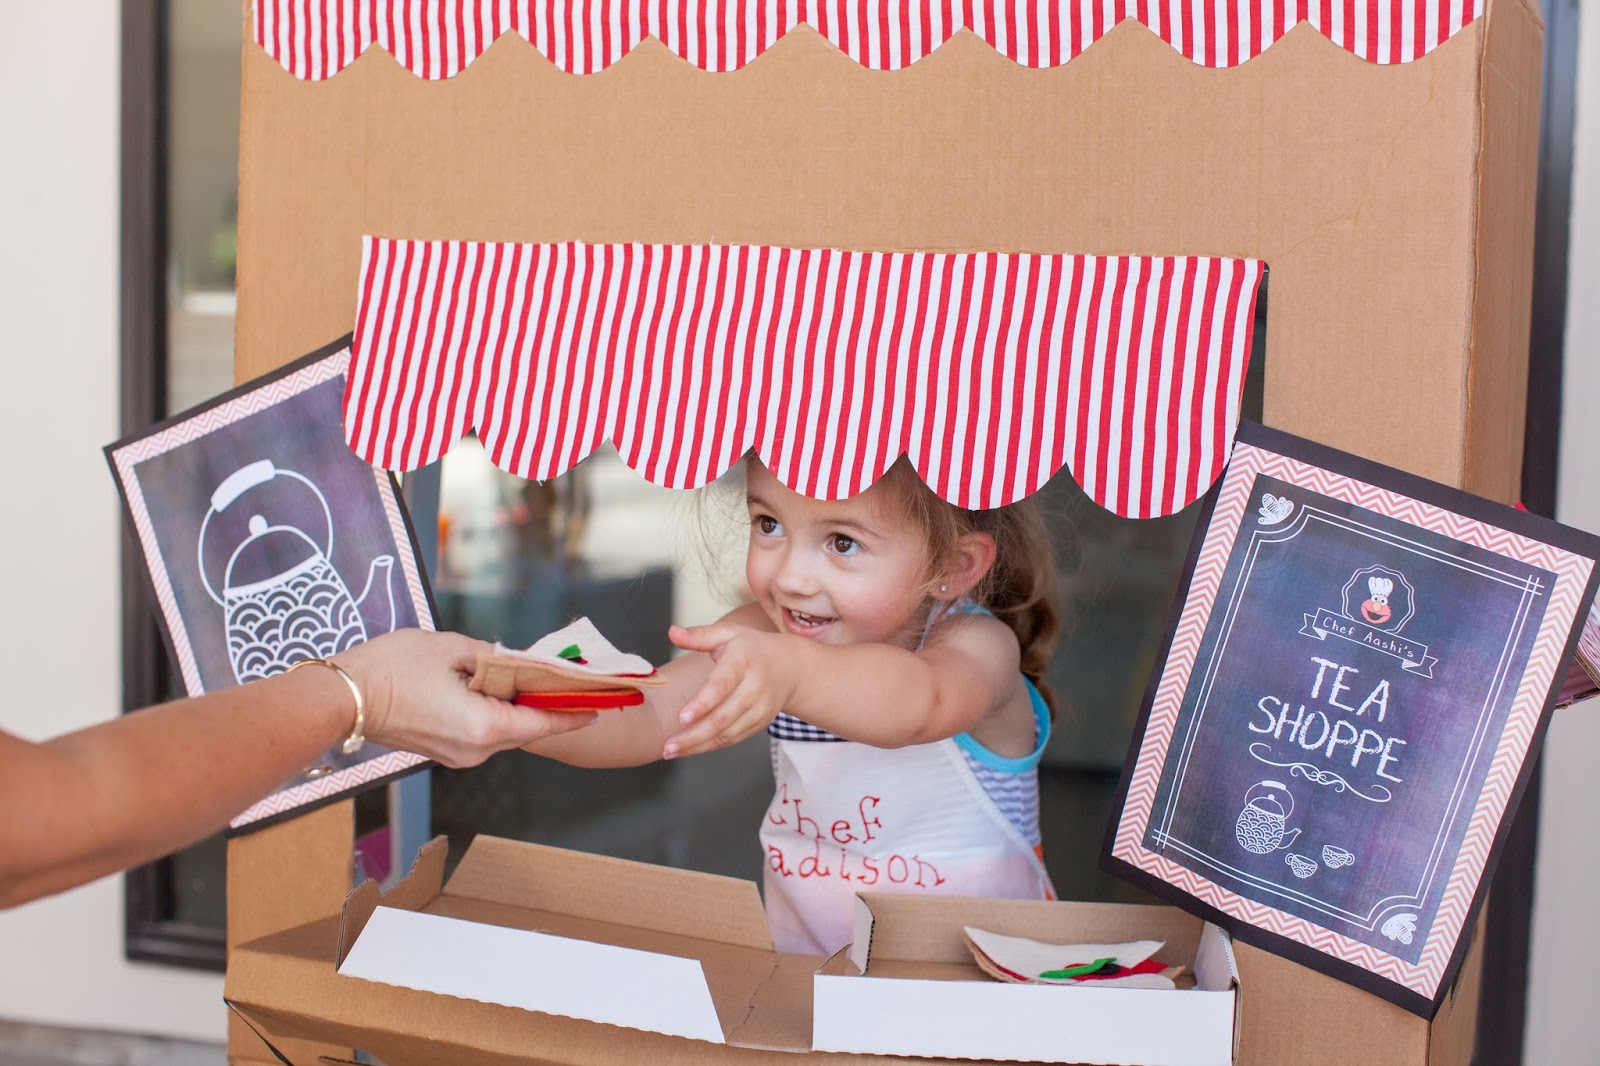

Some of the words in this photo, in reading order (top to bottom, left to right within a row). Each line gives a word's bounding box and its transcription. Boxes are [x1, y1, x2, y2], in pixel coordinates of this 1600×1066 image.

[1322, 616, 1355, 636] Chef
[1363, 631, 1414, 658] Aashi's
[1310, 656, 1390, 722] TEA
[1248, 695, 1407, 783] SHOPPE
[767, 838, 945, 887] adison
